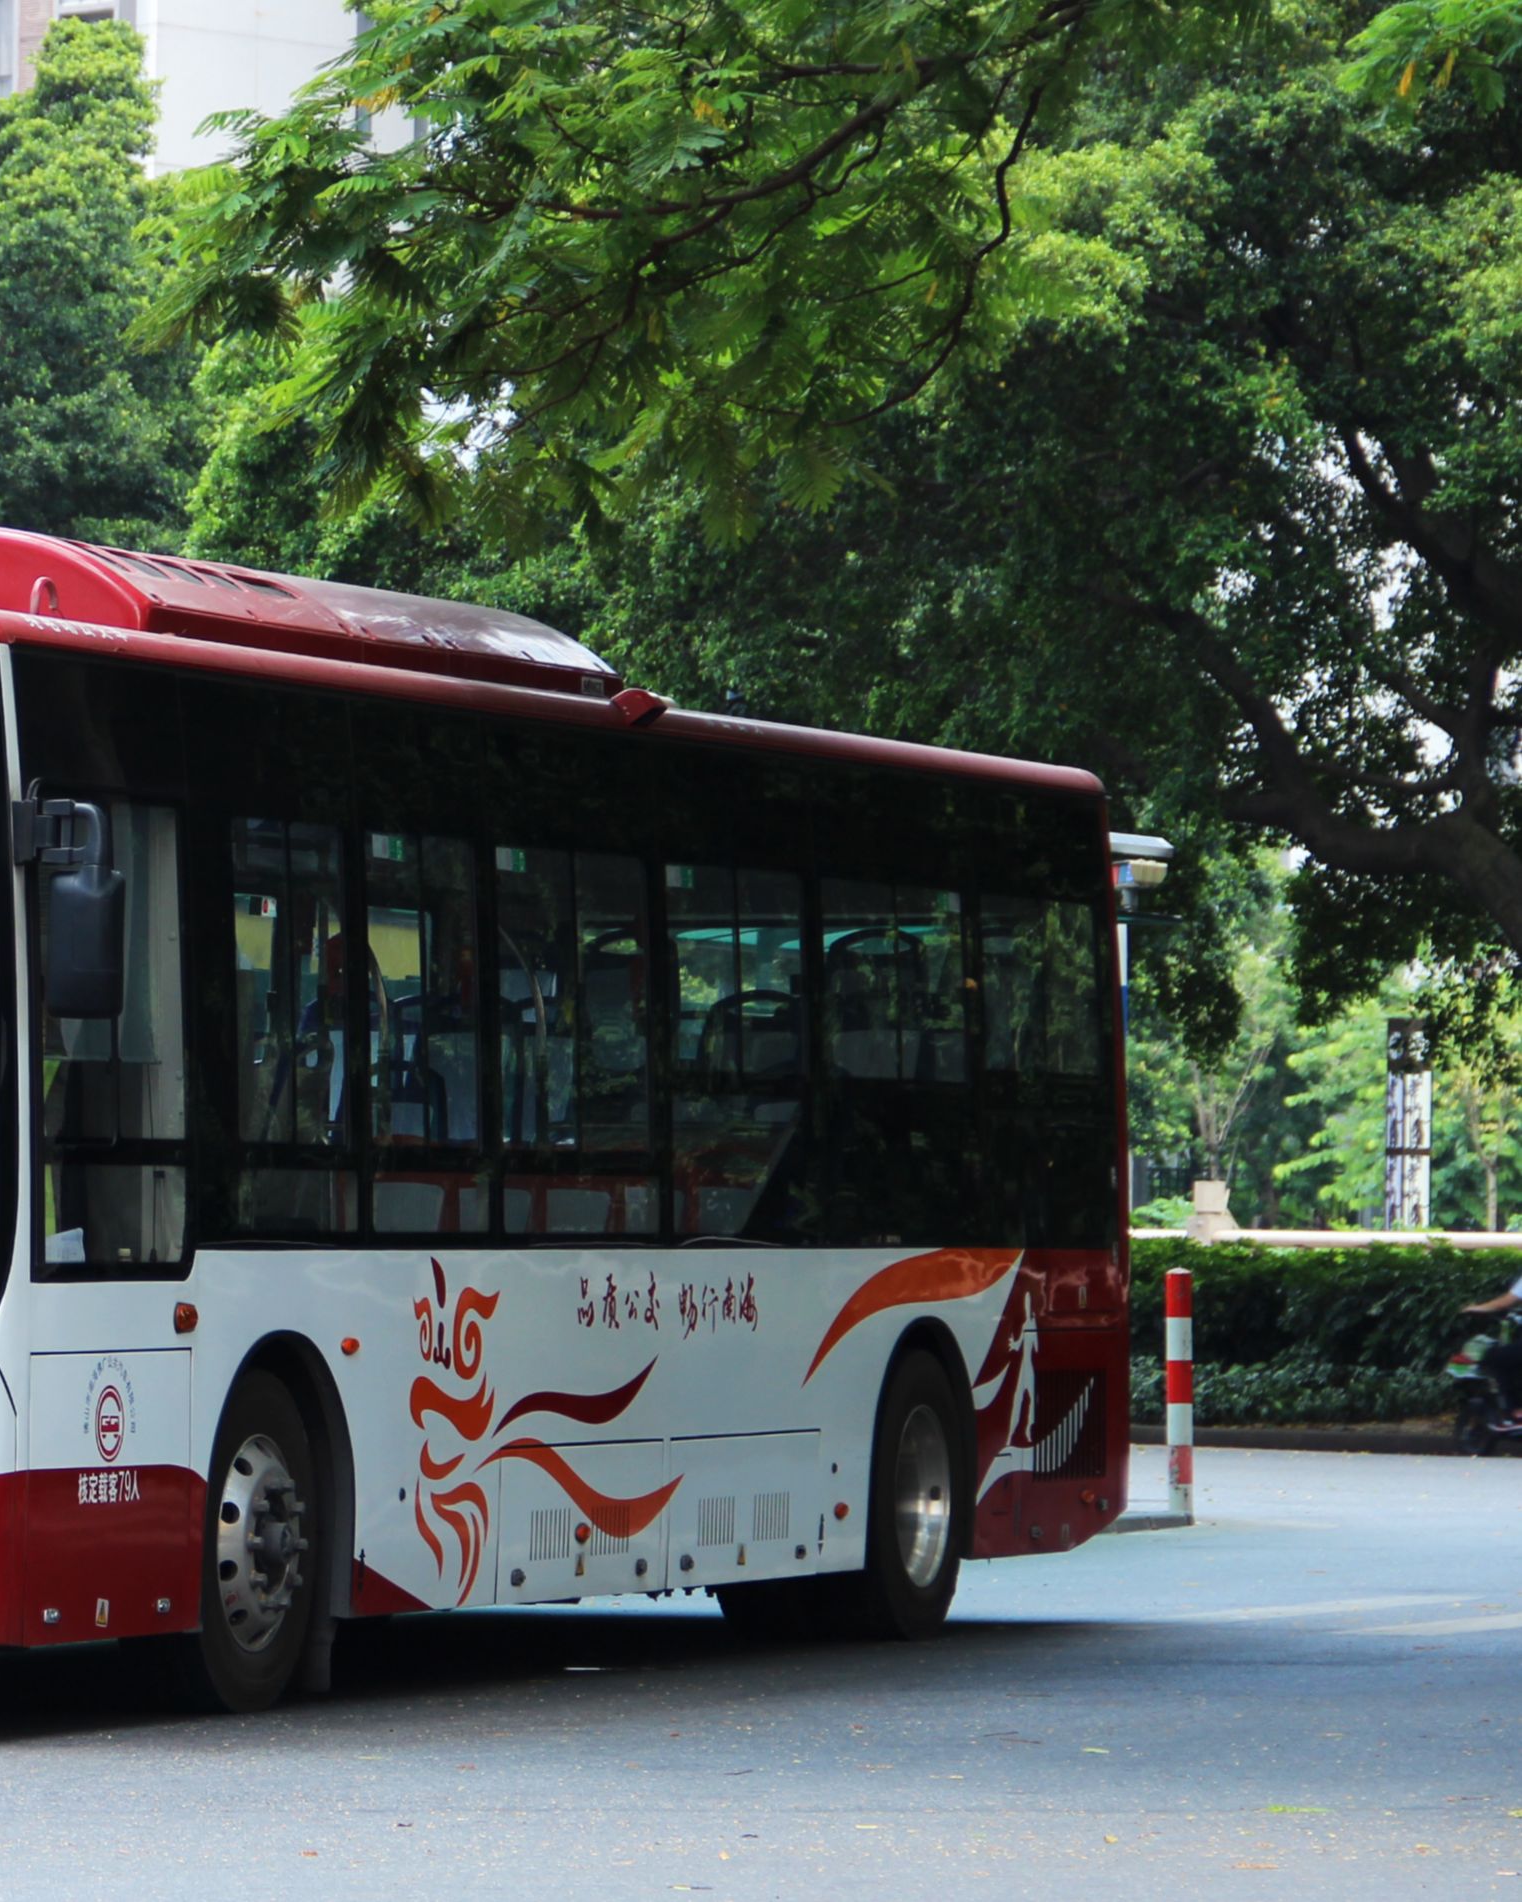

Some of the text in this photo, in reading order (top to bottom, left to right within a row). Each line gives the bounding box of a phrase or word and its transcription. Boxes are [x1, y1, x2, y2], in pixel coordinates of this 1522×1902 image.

[78, 1470, 140, 1505] 核定载客79人
